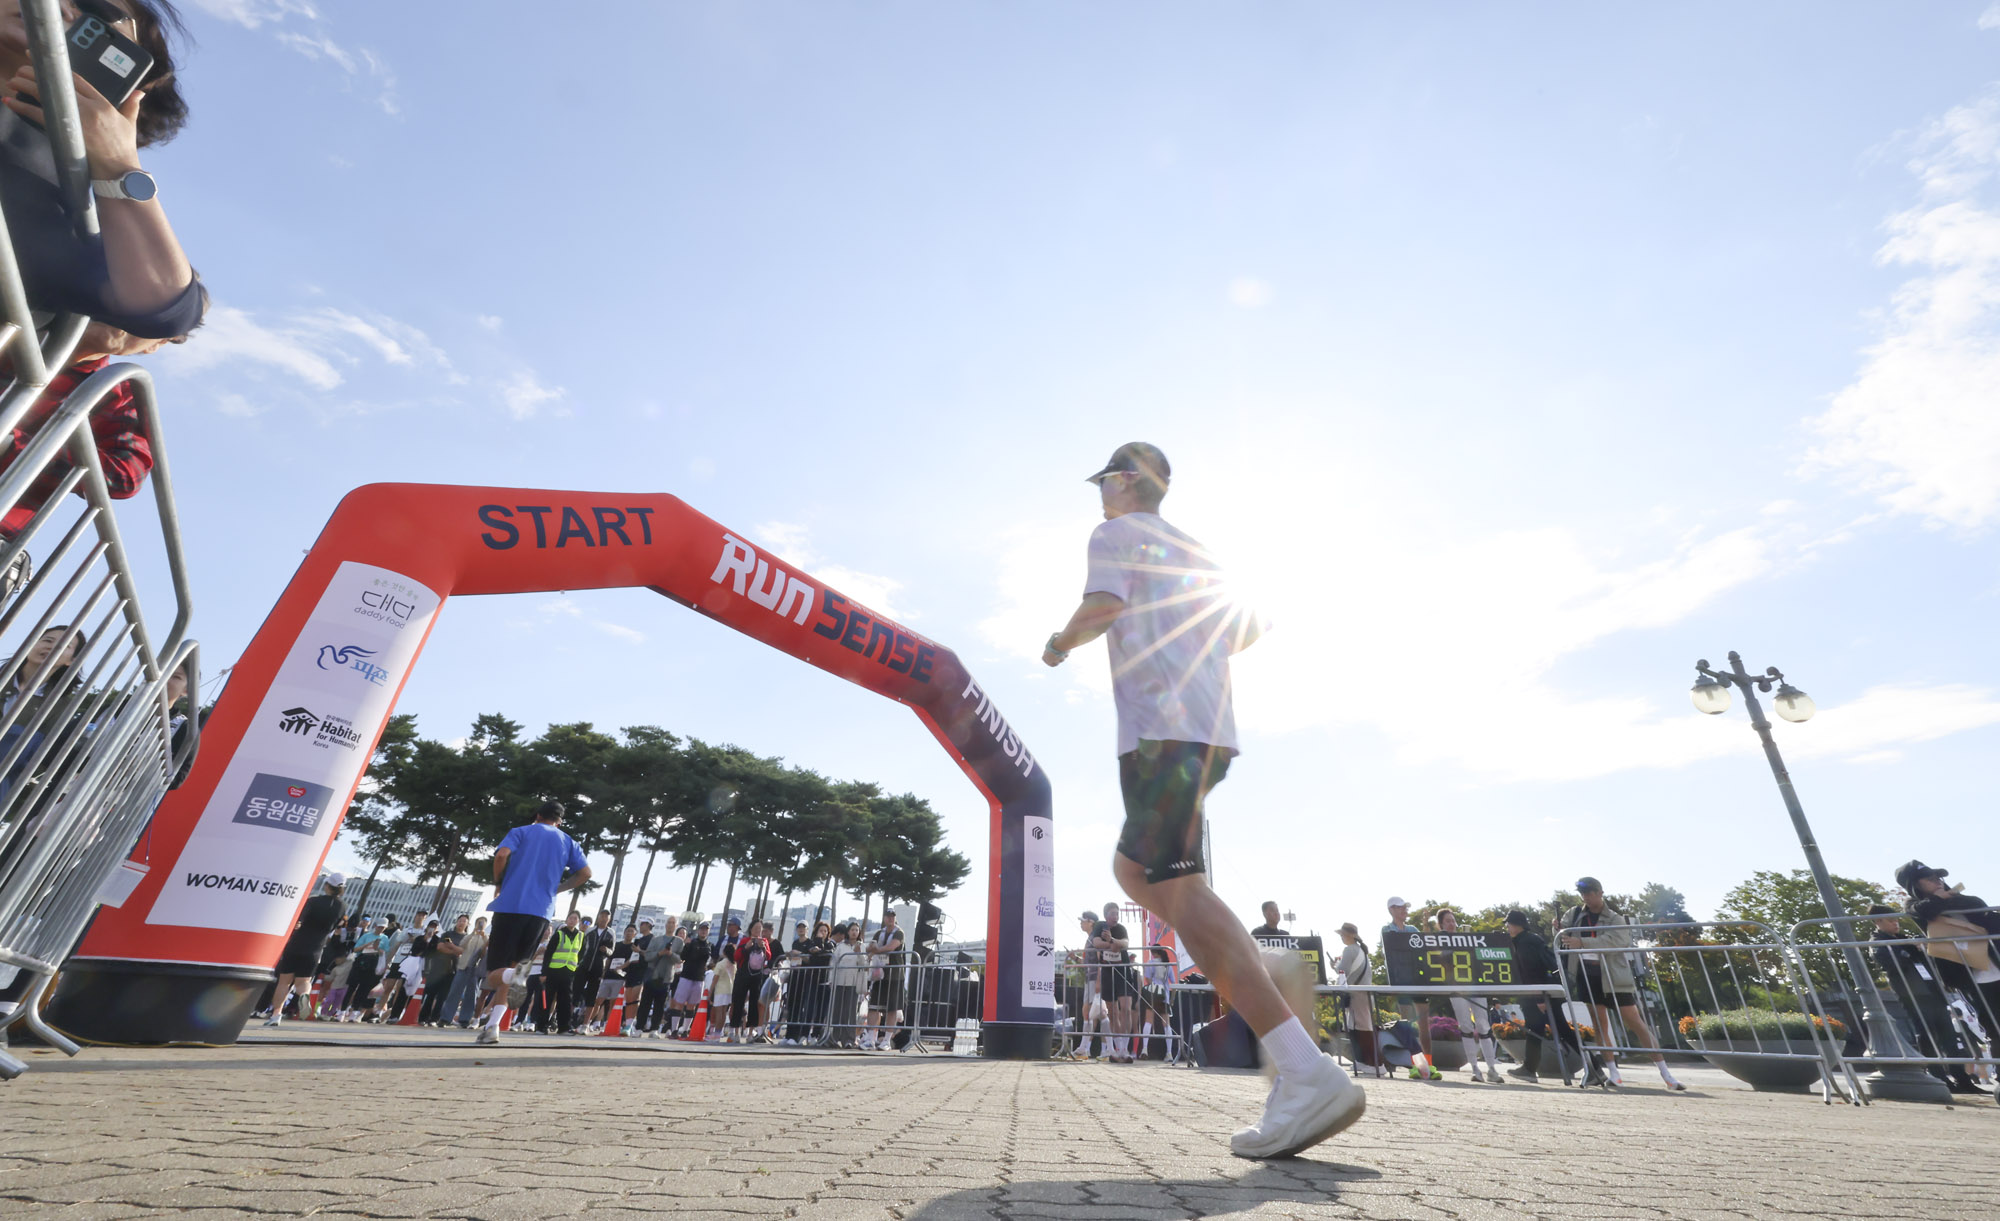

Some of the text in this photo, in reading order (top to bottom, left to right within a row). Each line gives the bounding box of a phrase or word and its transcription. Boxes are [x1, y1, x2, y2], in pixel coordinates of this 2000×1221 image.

[478, 504, 655, 550] START
[353, 606, 406, 629] daddy food
[319, 720, 362, 743] Habitat
[961, 677, 1035, 778] FINISH
[312, 740, 329, 749] Korea
[316, 732, 357, 751] for Humanity
[246, 796, 320, 828] 동원샘물
[186, 873, 260, 893] WOMAN
[260, 882, 299, 899] SENSE
[1257, 938, 1300, 949] AMIK
[1424, 935, 1487, 948] SAMIK
[1480, 949, 1507, 959] 10km
